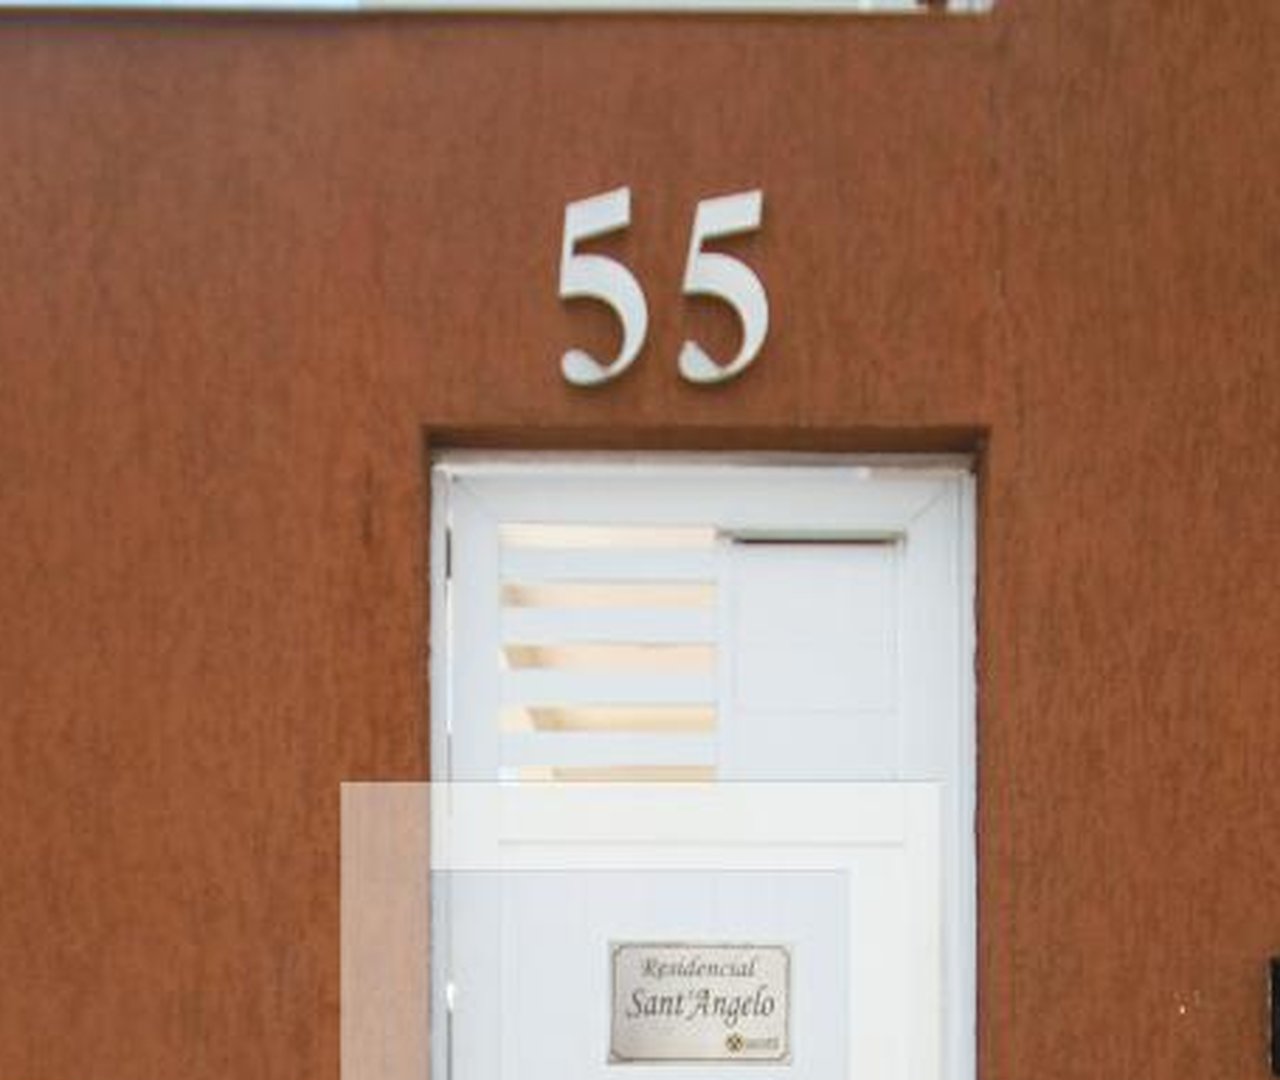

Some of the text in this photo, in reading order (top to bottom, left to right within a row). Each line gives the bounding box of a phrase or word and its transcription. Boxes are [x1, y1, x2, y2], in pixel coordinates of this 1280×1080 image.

[558, 185, 770, 386] 55
[640, 955, 757, 979] Residencial
[626, 984, 776, 1028] Sant'Angelo
